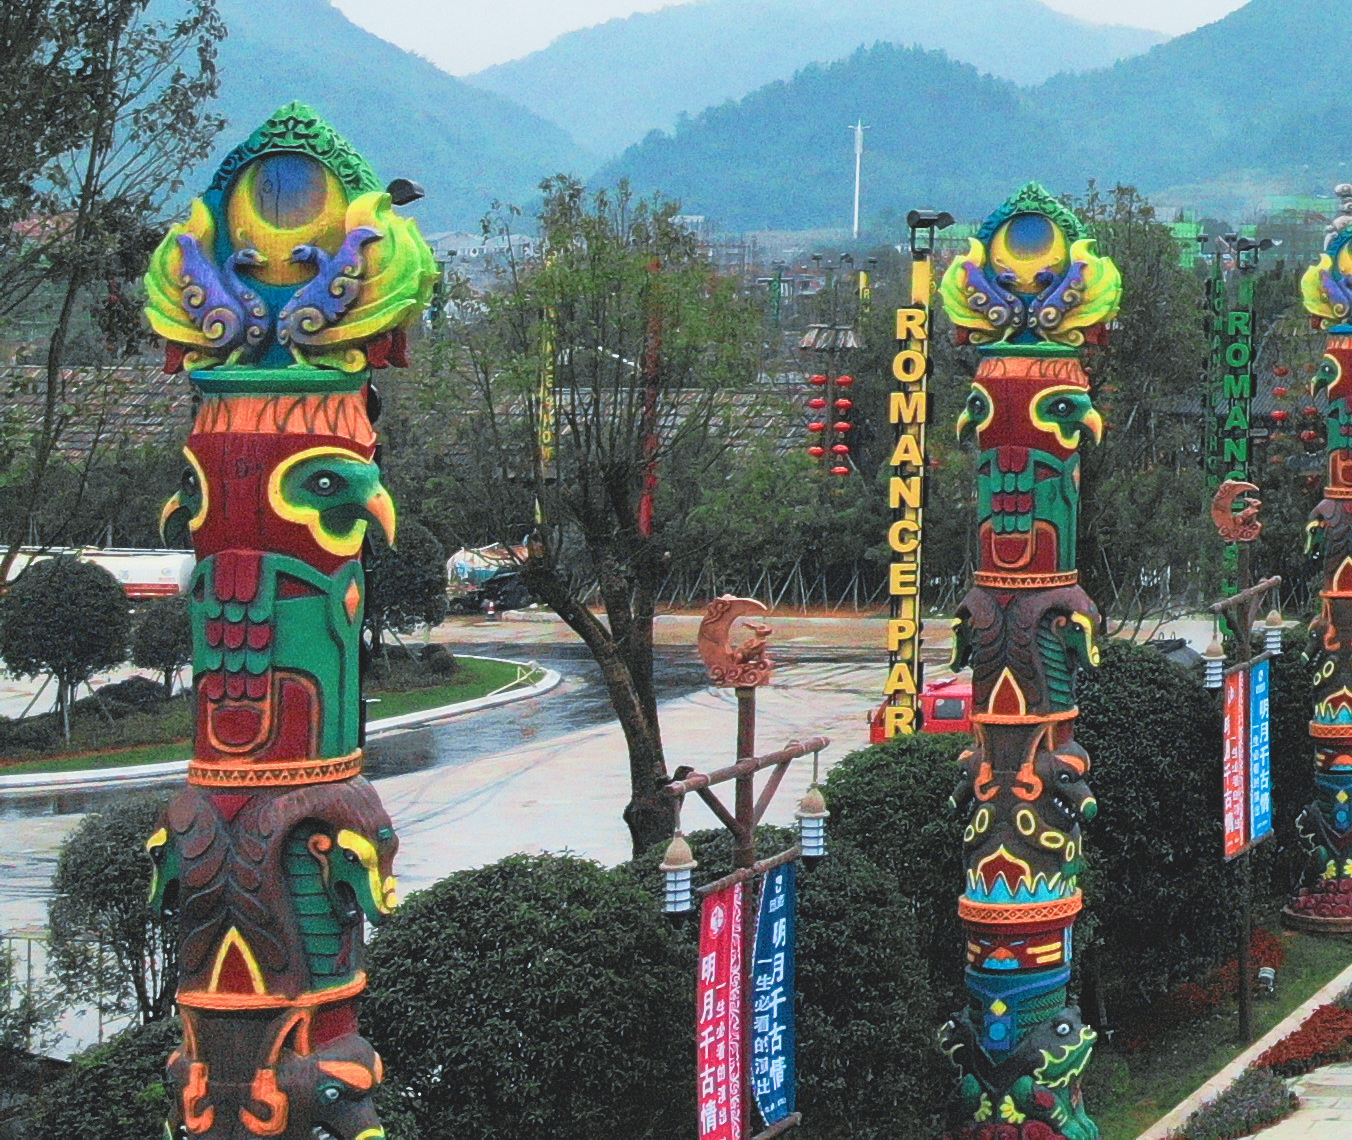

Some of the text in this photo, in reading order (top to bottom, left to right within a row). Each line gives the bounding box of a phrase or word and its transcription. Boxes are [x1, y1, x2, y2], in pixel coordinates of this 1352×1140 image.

[883, 307, 928, 739] ROMANCE PAR
[1258, 697, 1270, 814] 明月千古情
[699, 950, 718, 1136] 明月千古情
[769, 916, 788, 1092] 明月千古情
